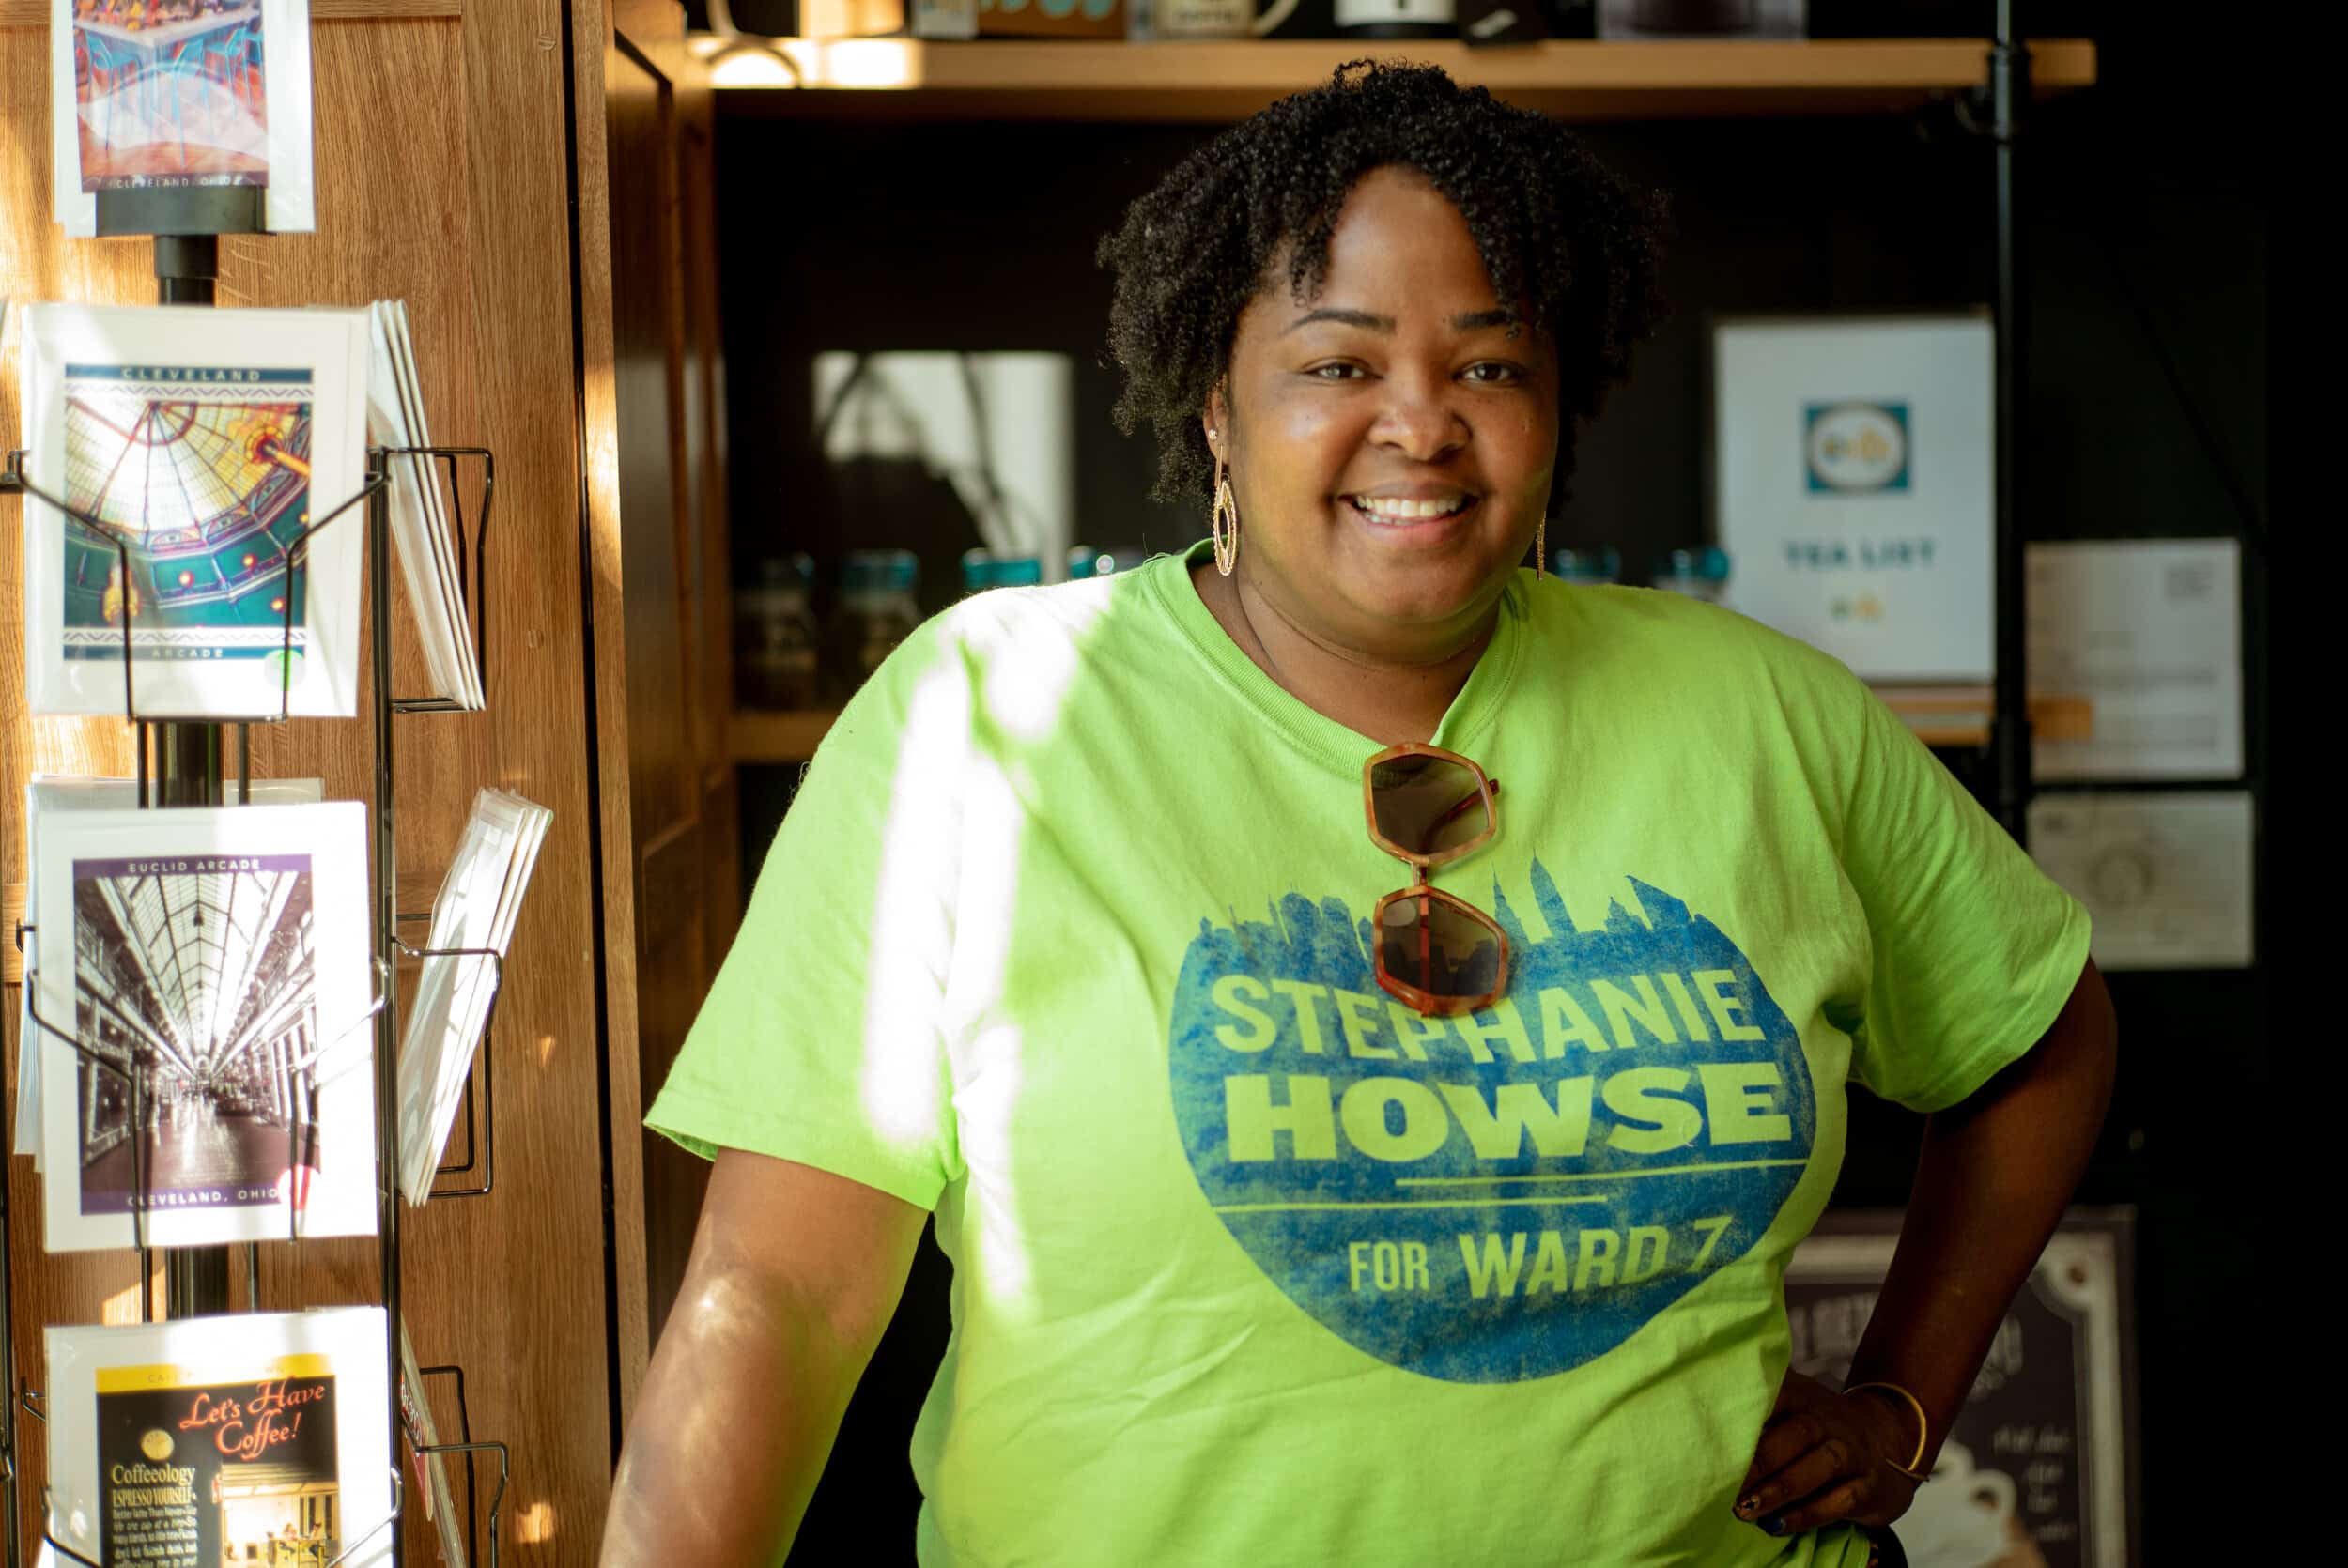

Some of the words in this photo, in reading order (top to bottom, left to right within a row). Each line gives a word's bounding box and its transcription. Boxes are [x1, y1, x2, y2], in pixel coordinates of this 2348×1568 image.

[121, 366, 261, 381] CLEVELAND
[152, 648, 224, 659] ARCADE
[128, 861, 188, 873] EUCLID
[196, 858, 260, 871] ARCADE
[1212, 968, 1767, 1064] STEPHANIE
[1224, 1062, 1793, 1163] HOWSE
[237, 1188, 279, 1202] OHIO
[1348, 1240, 1431, 1293] FOR
[1457, 1224, 1670, 1300] WARD
[1686, 1214, 1733, 1274] 7
[179, 1391, 241, 1430] Let's
[246, 1375, 325, 1416] Have
[215, 1408, 301, 1461] Coffee!
[112, 1463, 195, 1487] Coffeeology
